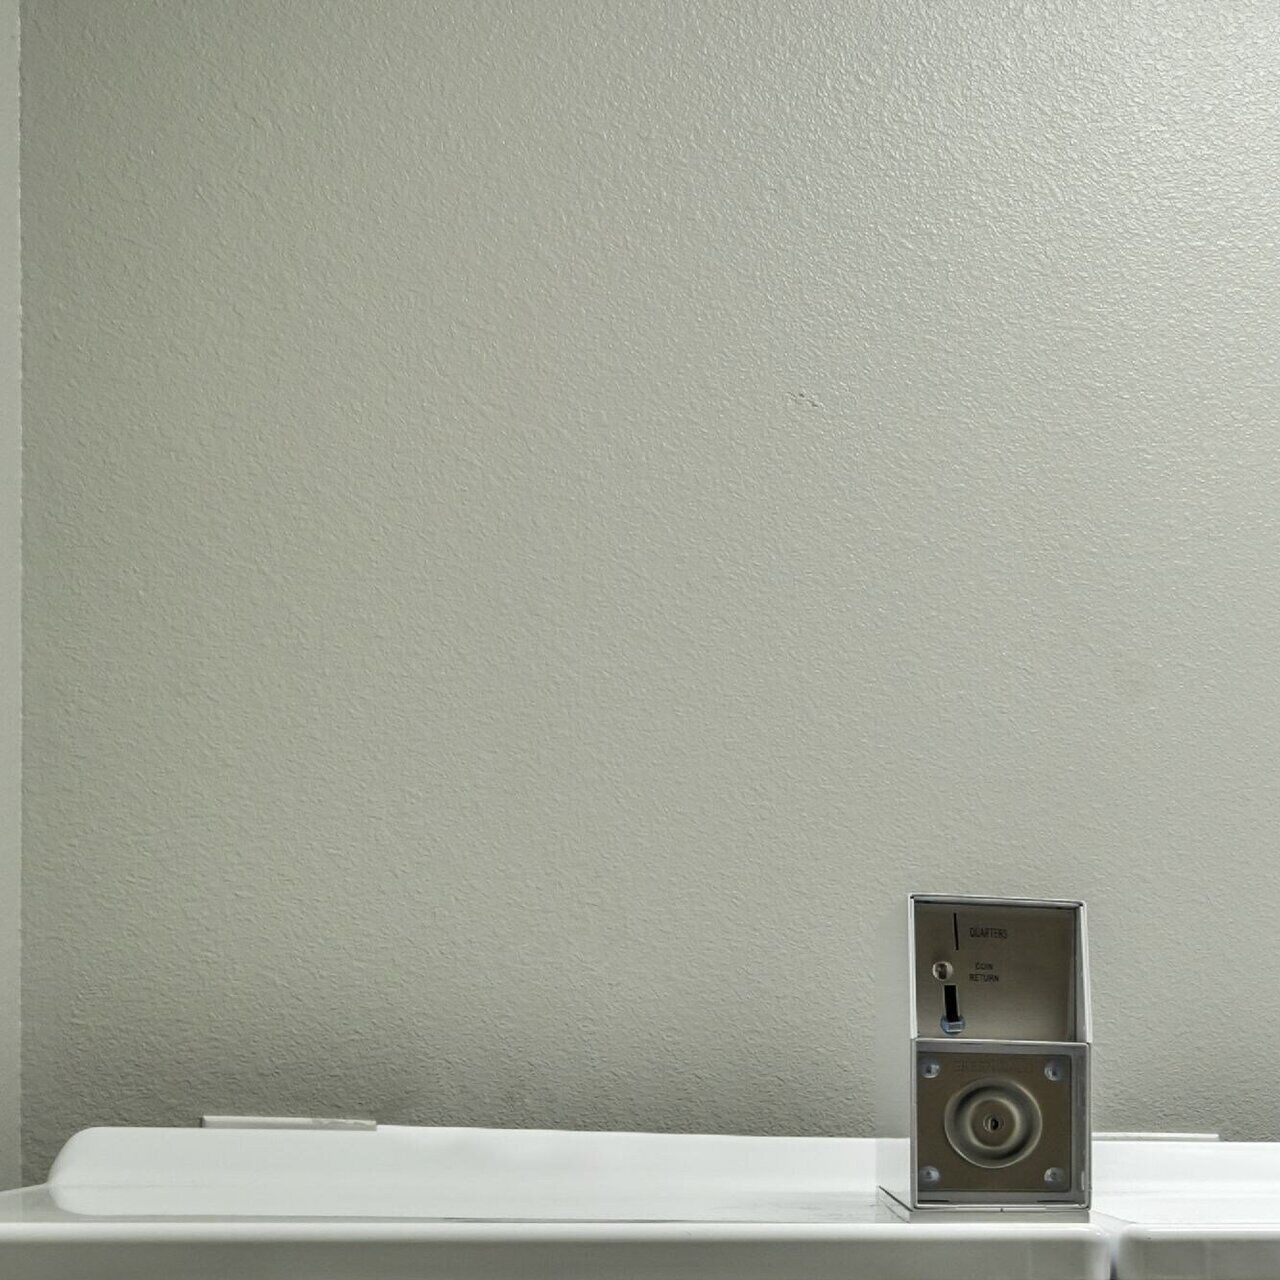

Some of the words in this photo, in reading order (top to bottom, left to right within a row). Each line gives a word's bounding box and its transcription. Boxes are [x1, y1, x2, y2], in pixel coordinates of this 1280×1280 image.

[970, 927, 1008, 939] QUARTERS
[975, 962, 993, 970] COIN
[969, 974, 999, 982] RETURN
